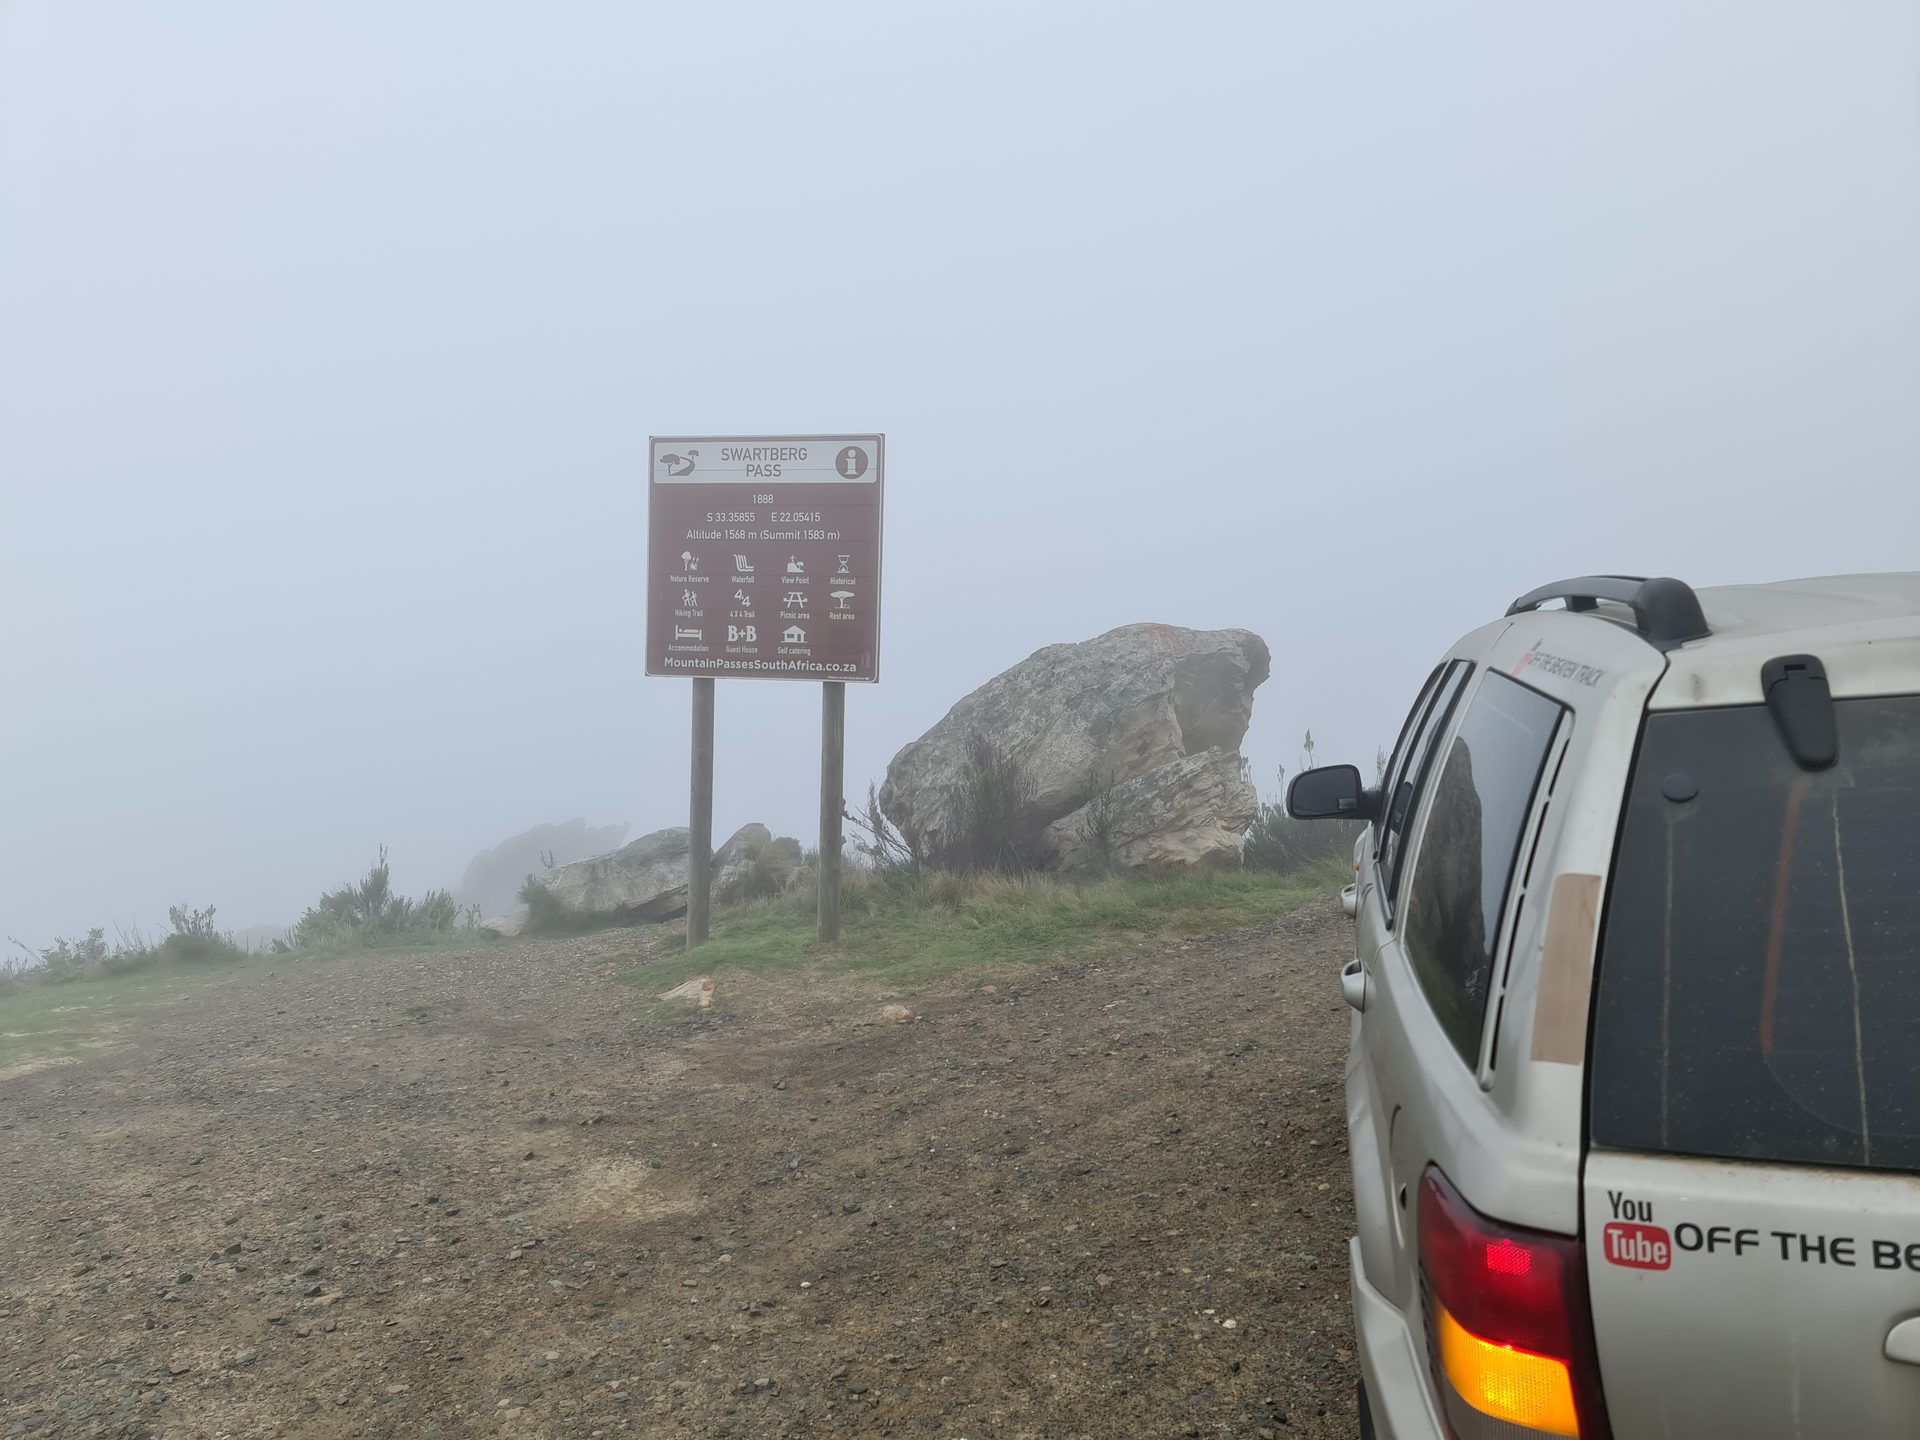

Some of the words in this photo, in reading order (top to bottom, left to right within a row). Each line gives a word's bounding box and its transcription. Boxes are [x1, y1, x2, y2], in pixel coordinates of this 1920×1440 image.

[721, 447, 807, 461] SWARTBERG
[746, 464, 781, 477] PASS
[753, 494, 774, 504] 1888
[706, 512, 713, 522] S
[715, 512, 755, 522] 33.35855
[771, 512, 777, 522] E
[780, 512, 821, 522] 22.05415
[686, 529, 721, 540] Altitude
[724, 530, 745, 540] 1568
[748, 532, 757, 540] m
[760, 529, 800, 541] (Summit
[803, 530, 825, 540] 1583
[827, 530, 840, 541] m)
[670, 575, 687, 583] Nature
[688, 575, 709, 583] Reserve
[731, 575, 755, 583] Waterfall
[781, 576, 795, 584] View
[795, 576, 809, 585] Point
[830, 577, 856, 585] Historical
[675, 609, 691, 618] Hiking
[692, 609, 704, 617] Trail
[744, 610, 755, 618] Trail
[780, 611, 797, 619] Picnic
[829, 612, 842, 620] Rest
[727, 625, 757, 642] B+B
[668, 644, 709, 652] Accommodation
[726, 645, 741, 653] Guest
[741, 645, 758, 654] House
[777, 646, 787, 655] Self
[789, 647, 811, 656] catering
[664, 657, 857, 672] MountainPassesSouthAfrica.co.za
[1607, 1190, 1653, 1222] You
[1607, 1228, 1668, 1264] Tube
[1674, 1222, 1760, 1256] OFF
[1770, 1231, 1857, 1267] THE
